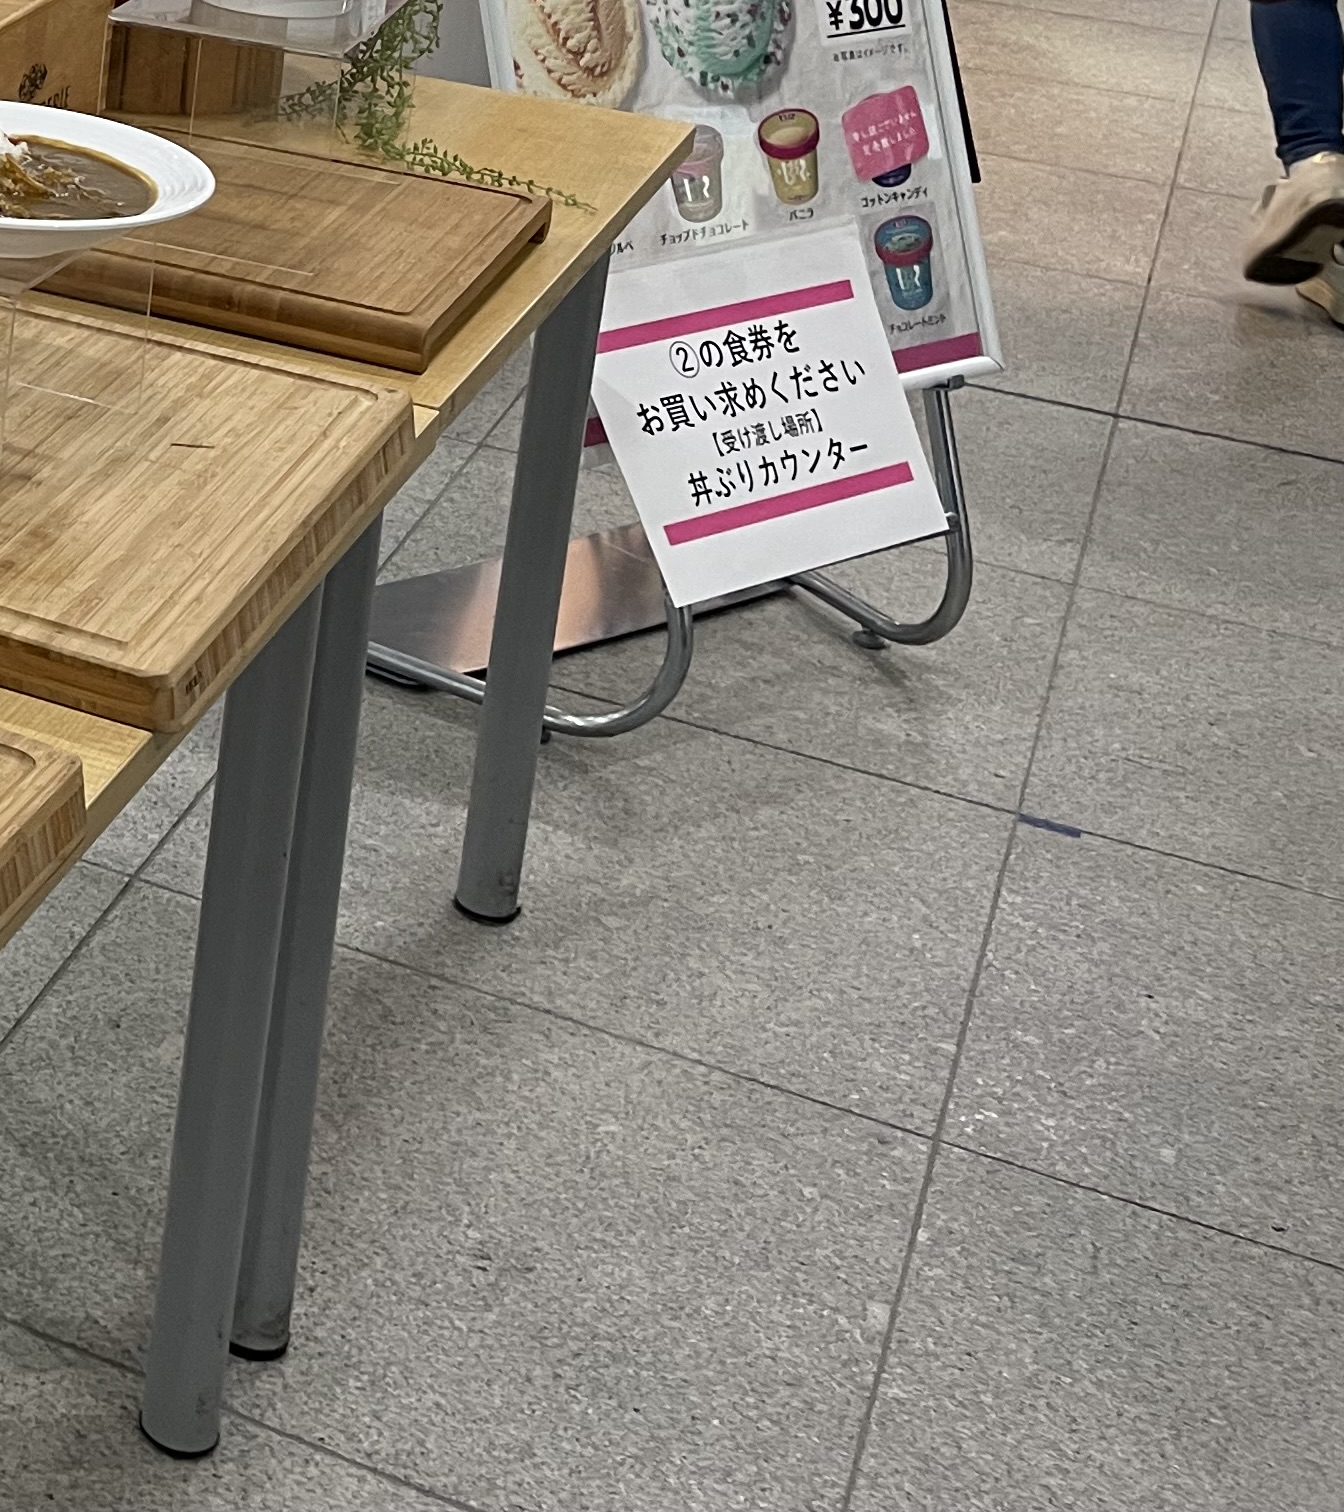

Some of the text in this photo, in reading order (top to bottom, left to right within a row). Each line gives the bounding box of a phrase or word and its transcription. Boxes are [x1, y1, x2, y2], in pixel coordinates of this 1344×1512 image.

[860, 185, 929, 208] コットンキャンディ
[659, 218, 750, 246] チョップドチョコレート
[668, 319, 801, 379] ②の食券を
[636, 358, 867, 437] お買い求めください
[687, 437, 869, 507] 丼ぶりカウンター
